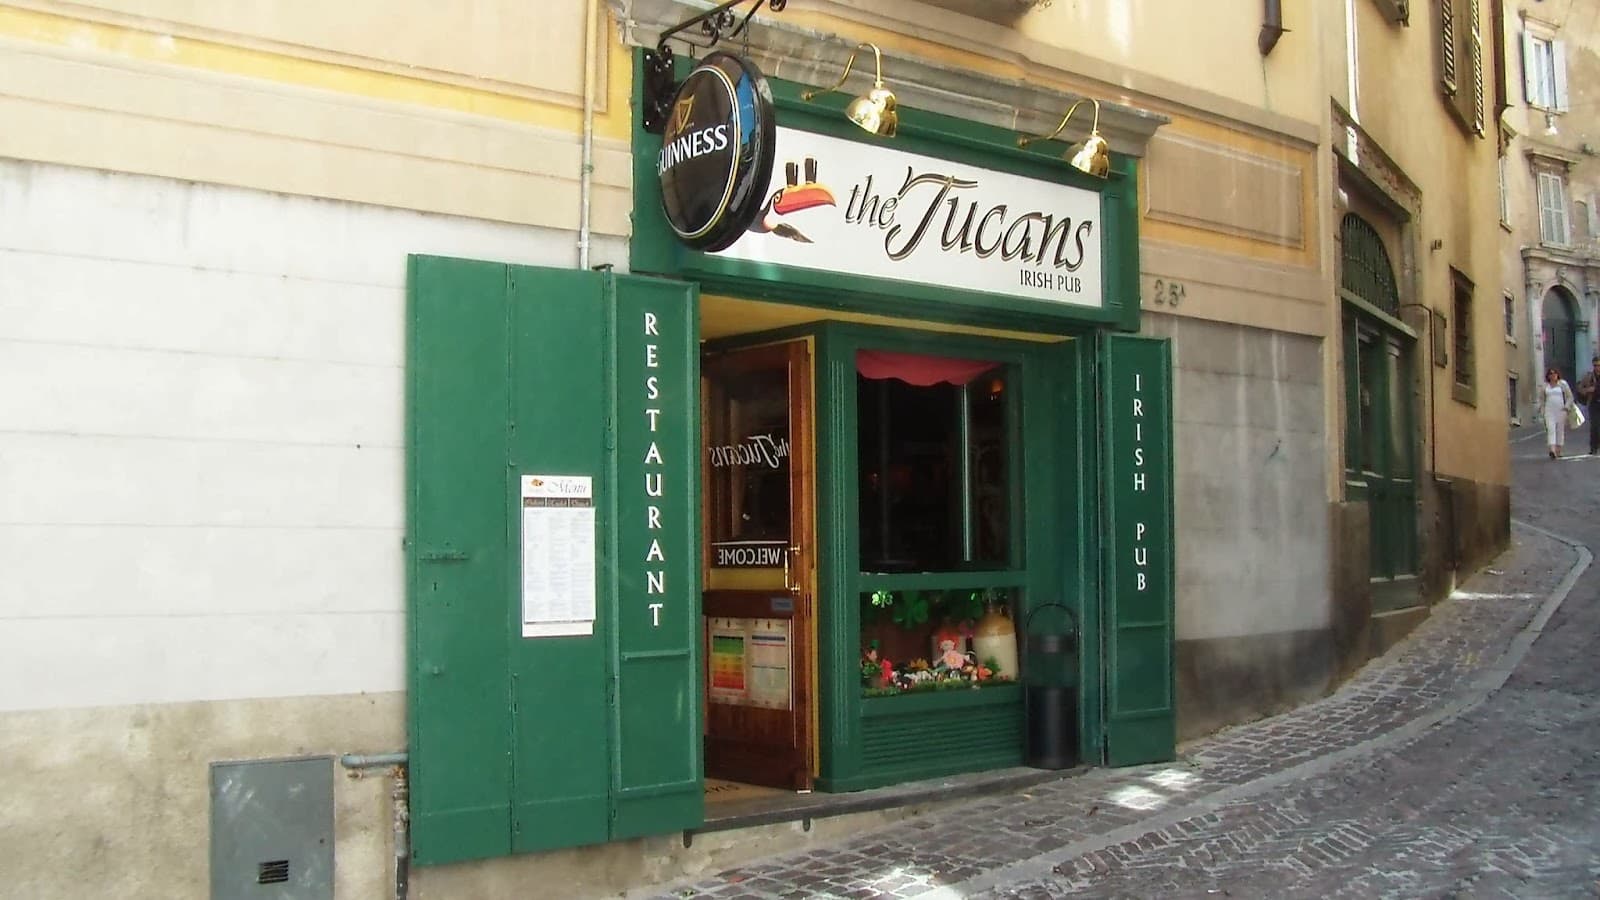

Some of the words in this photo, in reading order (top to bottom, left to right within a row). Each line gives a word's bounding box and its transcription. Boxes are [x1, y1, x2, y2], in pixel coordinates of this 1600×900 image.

[656, 124, 729, 176] GUINNESS
[845, 174, 898, 230] the
[884, 165, 1093, 272] Tucans
[1020, 269, 1053, 290] IRISH
[1057, 275, 1082, 293] PUB
[644, 313, 665, 627] RESTAURANT
[1133, 373, 1146, 491] IRISH
[1134, 522, 1147, 591] PUB
